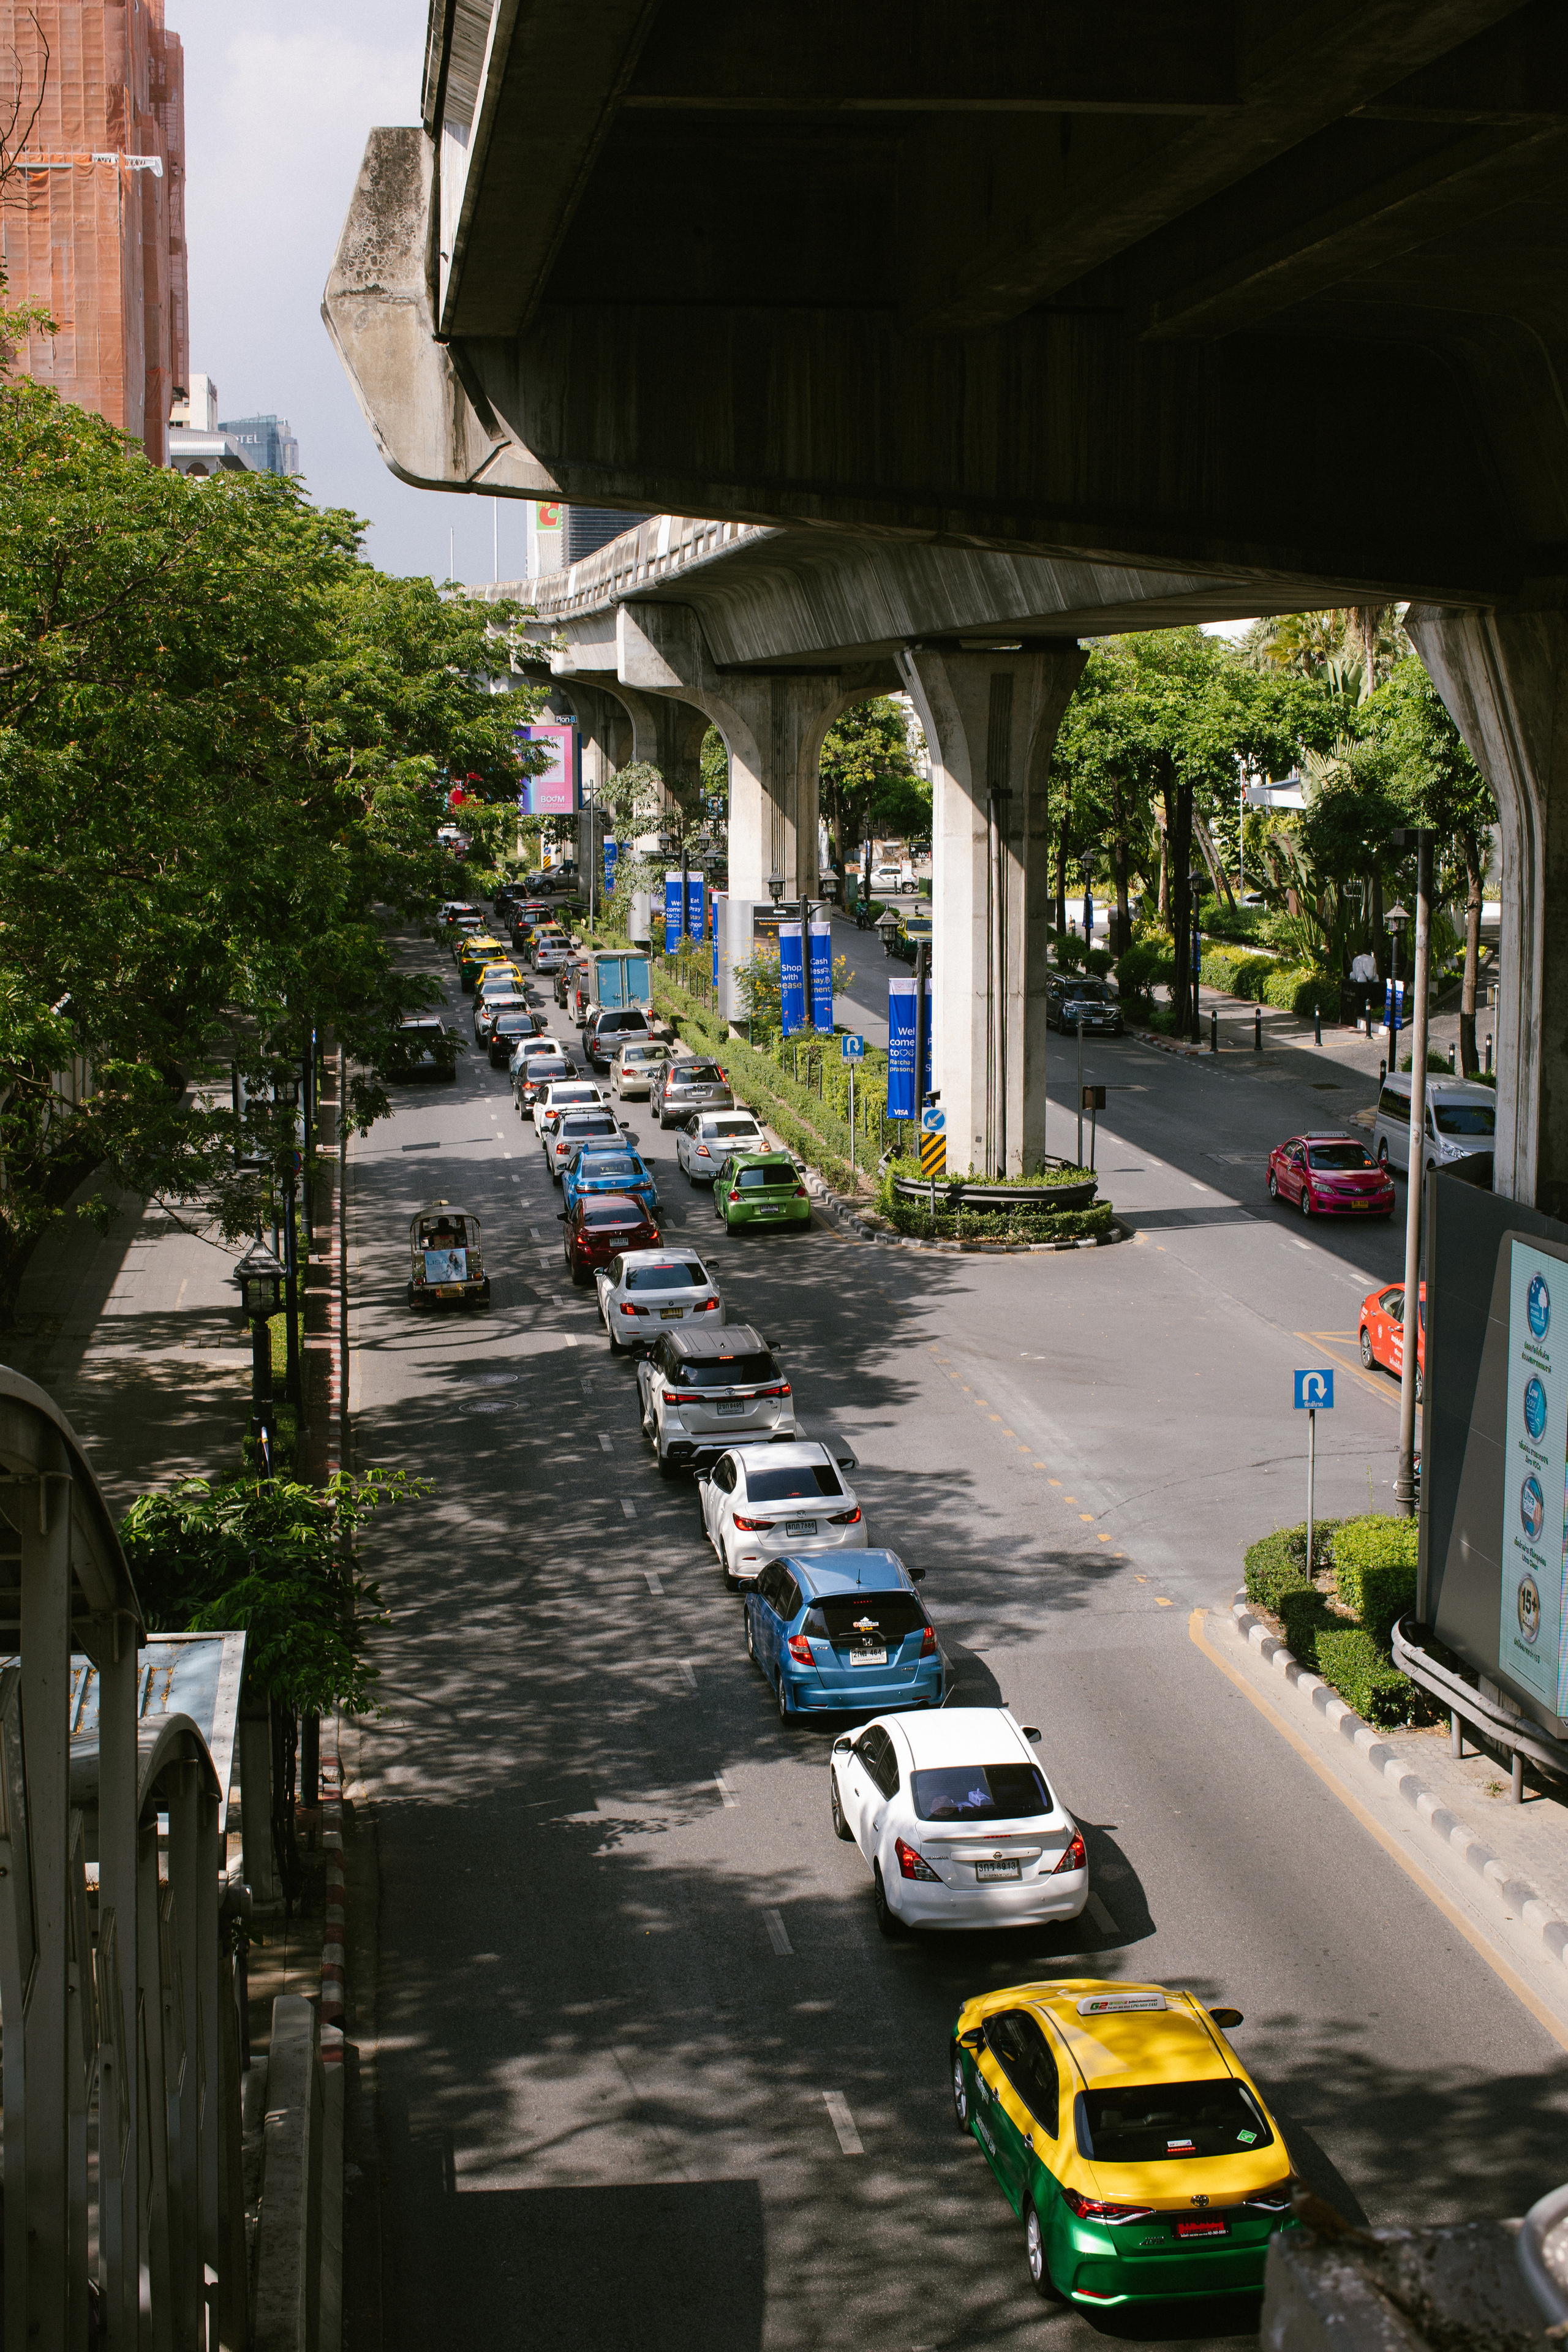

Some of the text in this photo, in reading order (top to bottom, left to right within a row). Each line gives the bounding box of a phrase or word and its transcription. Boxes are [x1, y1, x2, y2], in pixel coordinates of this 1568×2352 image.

[237, 432, 262, 443] TEL
[782, 965, 802, 973] Shop
[898, 1027, 915, 1036] Wel
[1529, 1388, 1538, 1399] Low
[1521, 1586, 1537, 1615] 15+
[1090, 2002, 1109, 2010] G2
